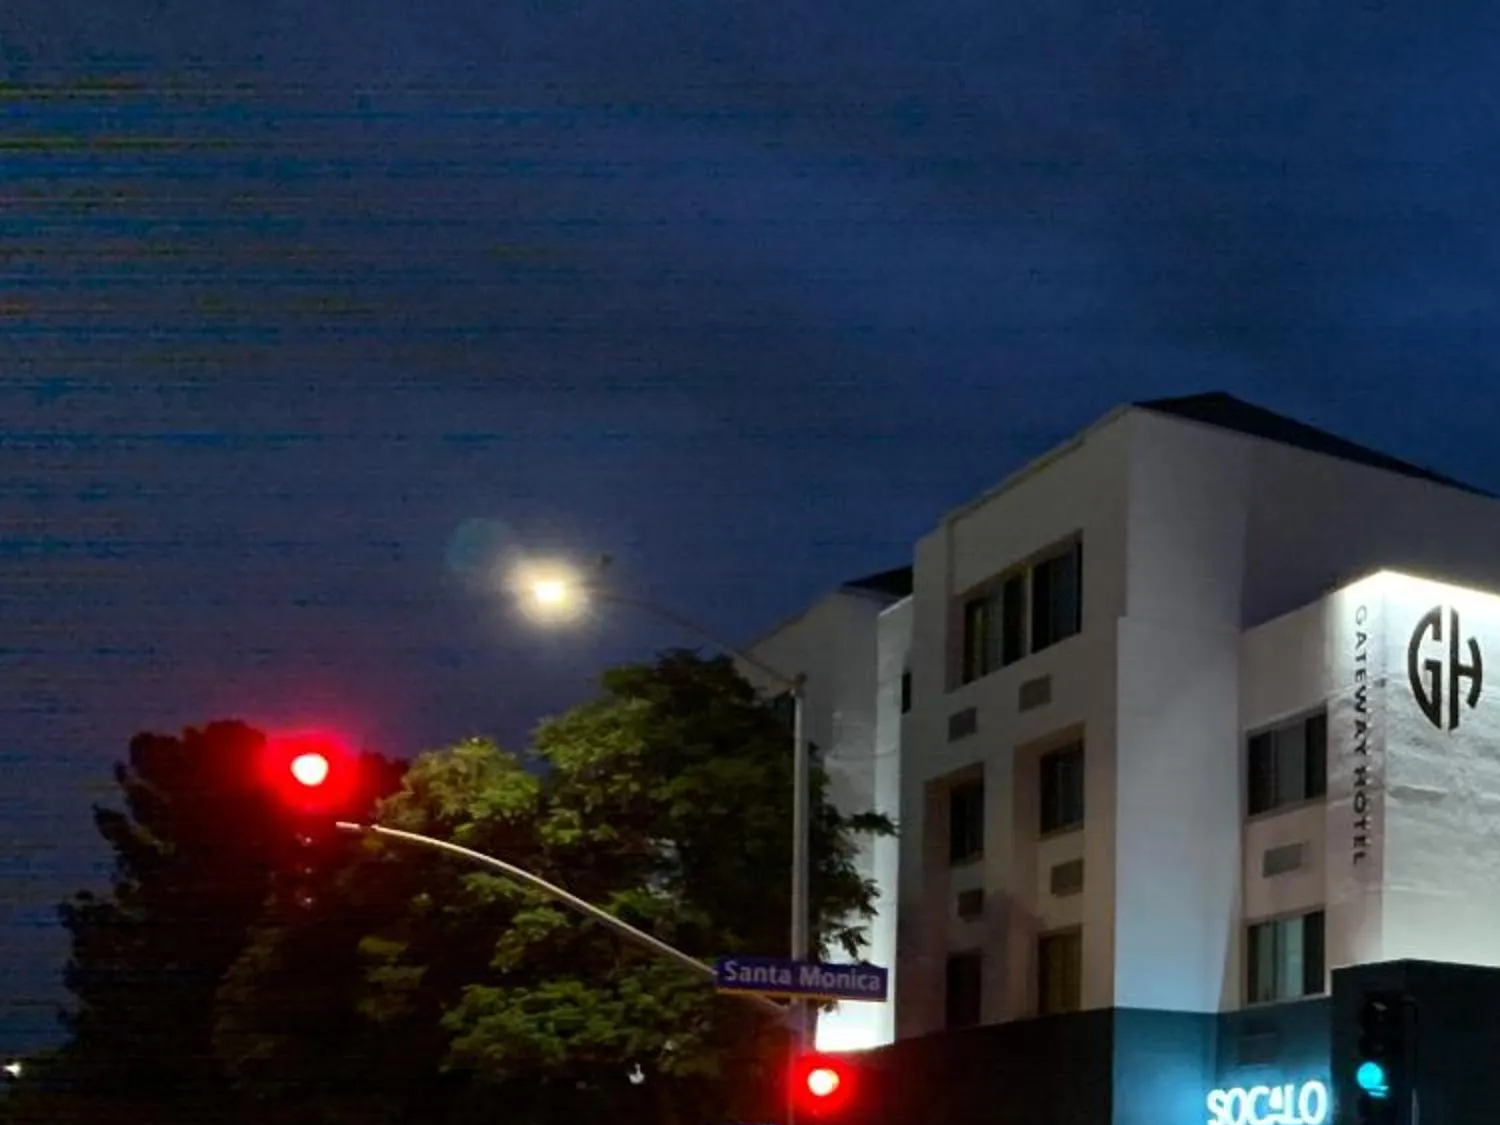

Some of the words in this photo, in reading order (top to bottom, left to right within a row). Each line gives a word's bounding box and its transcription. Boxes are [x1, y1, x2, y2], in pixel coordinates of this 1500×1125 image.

[1354, 605, 1367, 756] GATEWAY
[1407, 604, 1483, 732] GH
[1353, 766, 1367, 865] HOTEL
[724, 960, 792, 985] Santa
[800, 966, 881, 991] Monica
